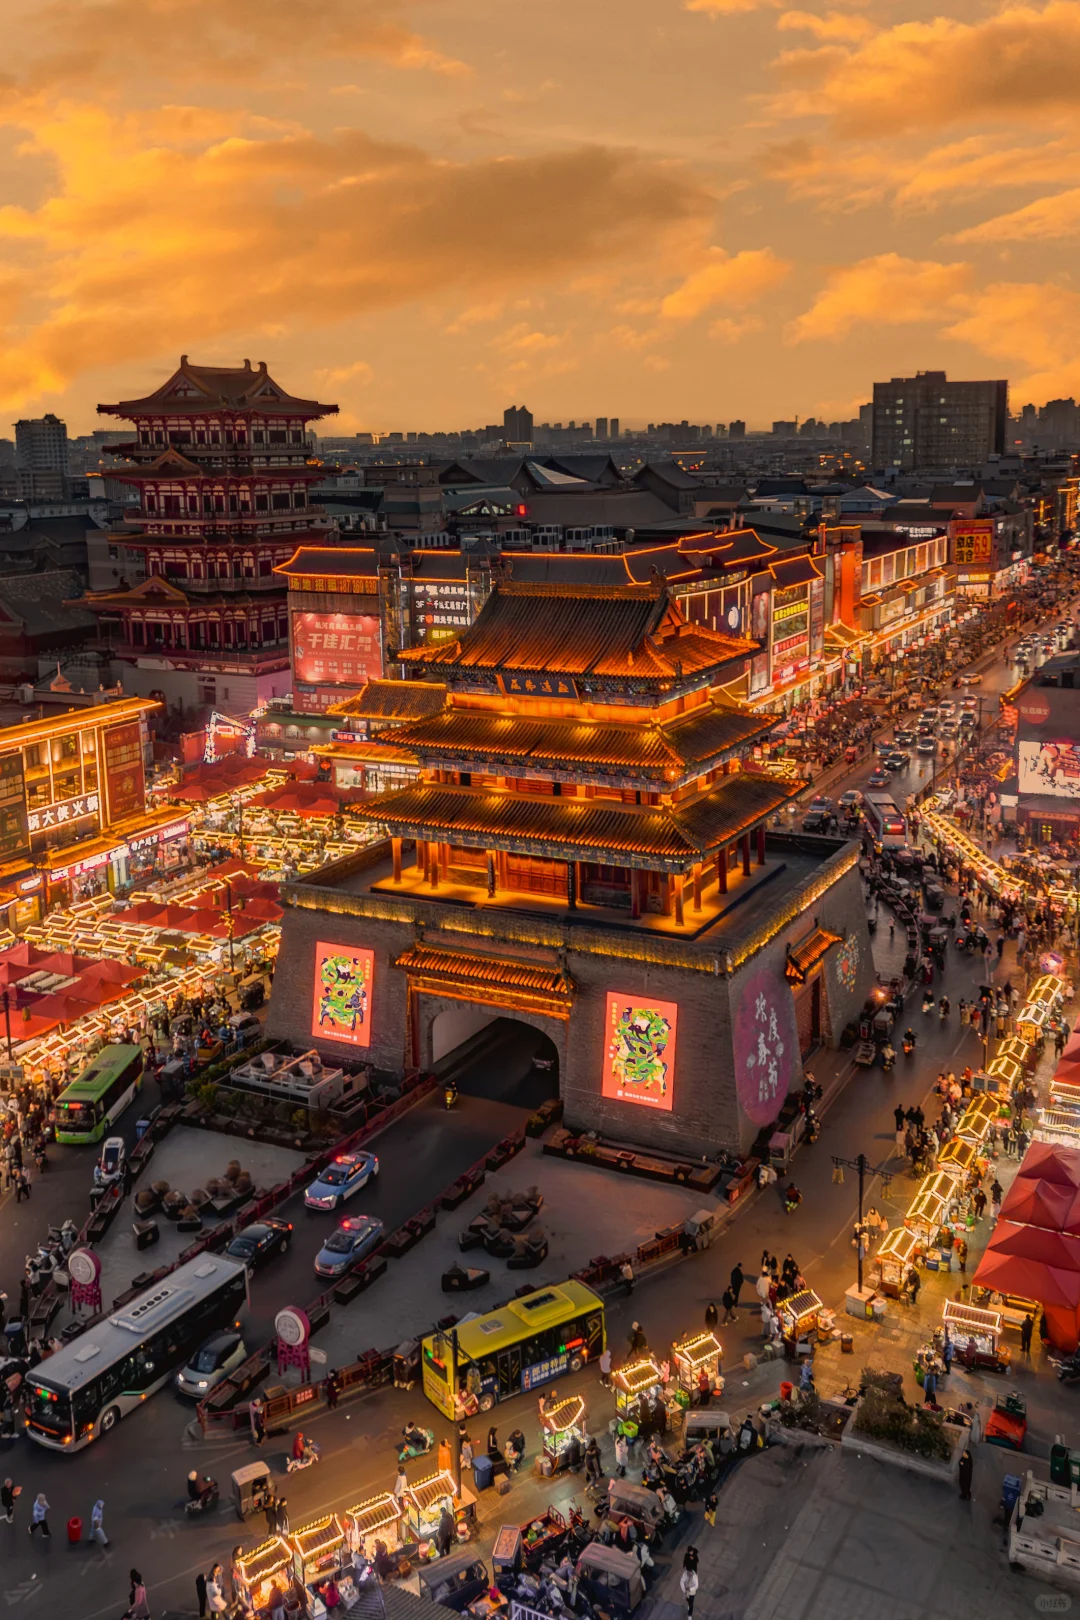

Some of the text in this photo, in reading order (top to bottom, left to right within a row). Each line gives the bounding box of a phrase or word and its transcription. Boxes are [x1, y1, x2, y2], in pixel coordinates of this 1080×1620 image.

[415, 600, 425, 609] 3F
[27, 796, 99, 831] 锅大侠火锅
